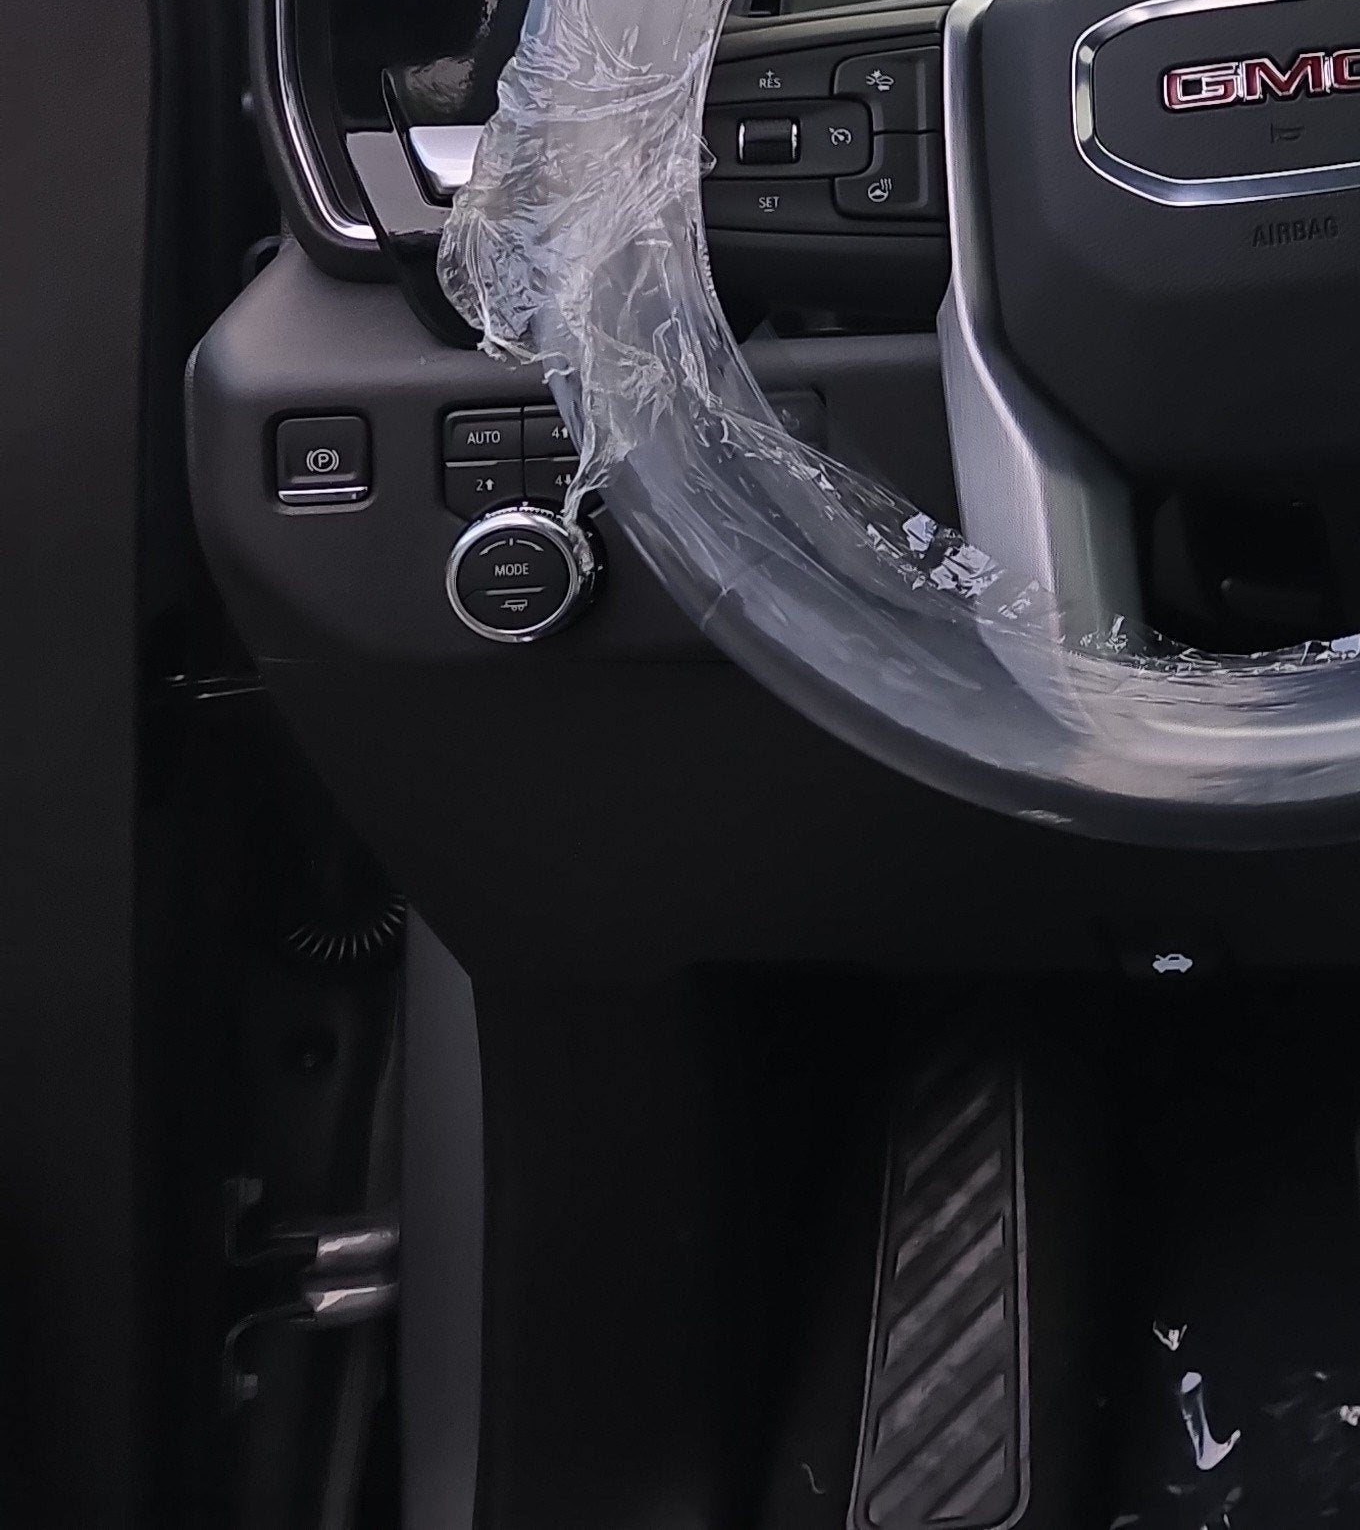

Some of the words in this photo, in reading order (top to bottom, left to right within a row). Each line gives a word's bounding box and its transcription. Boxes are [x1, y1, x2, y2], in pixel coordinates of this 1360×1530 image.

[759, 77, 782, 90] RES
[758, 196, 780, 209] SET
[1252, 218, 1340, 248] AIRBAG
[466, 430, 501, 446] AUTO
[495, 562, 529, 577] MODE
